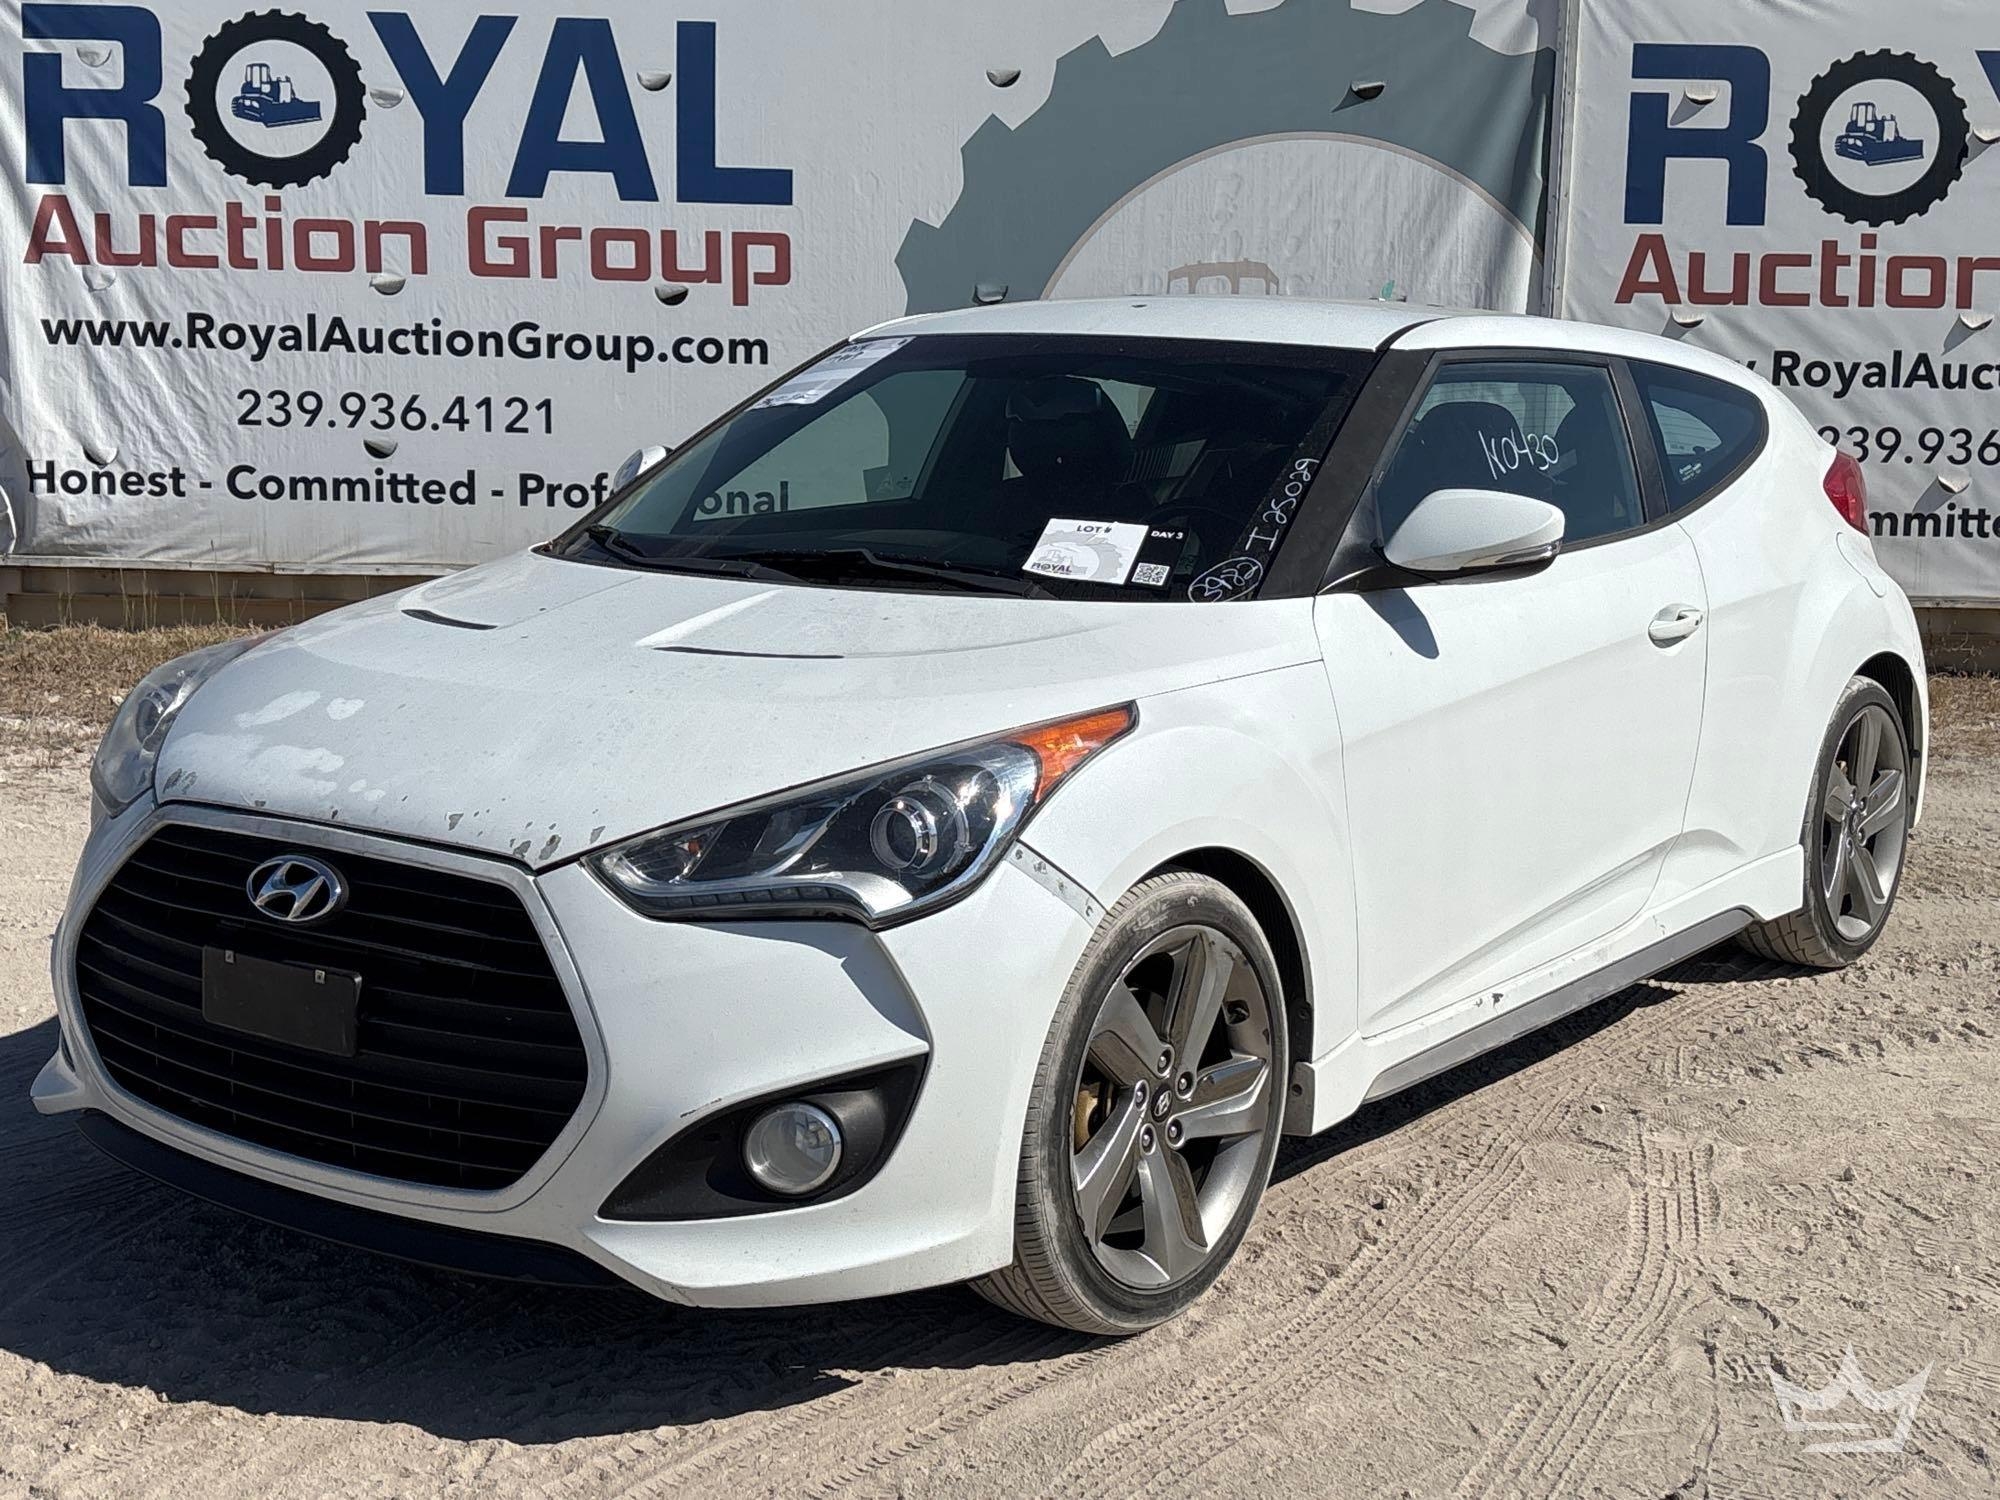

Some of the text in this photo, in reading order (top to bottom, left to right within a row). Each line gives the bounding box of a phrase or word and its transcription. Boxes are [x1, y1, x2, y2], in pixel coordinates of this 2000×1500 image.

[22, 3, 794, 206] ROYAL
[1623, 43, 2000, 228] RO
[24, 193, 793, 307] Auction Group
[42, 313, 769, 374] www.RoyalAuctionGroup.com
[237, 388, 554, 436] 239.936.4121
[25, 460, 187, 498] Honest
[227, 464, 477, 508] Committed
[1076, 524, 1101, 534] LOT
[1151, 530, 1173, 539] DAY
